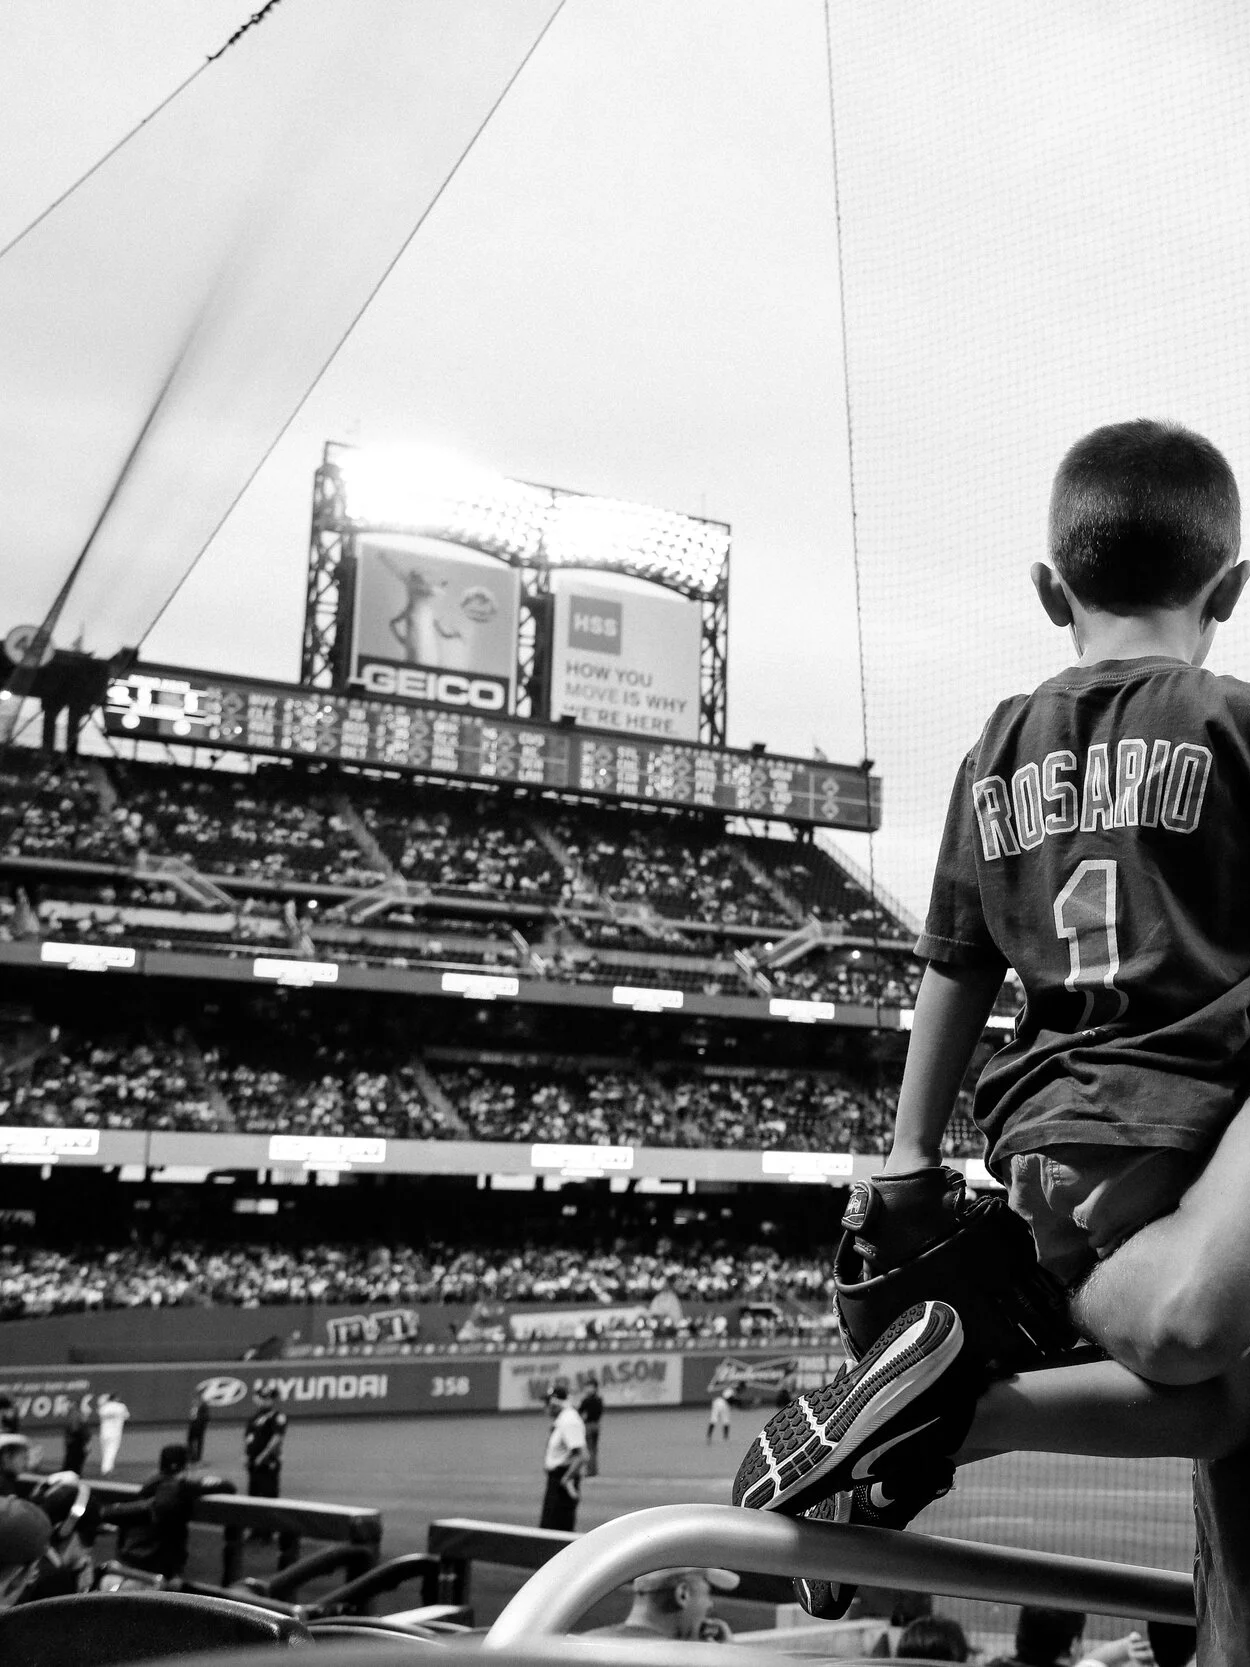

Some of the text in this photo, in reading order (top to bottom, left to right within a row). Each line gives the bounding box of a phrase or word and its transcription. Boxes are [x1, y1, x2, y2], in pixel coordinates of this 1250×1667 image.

[573, 612, 618, 637] HSS
[361, 662, 506, 711] GEICO
[566, 660, 653, 689] HOW YOU
[565, 682, 688, 713] MOVE IS WHY
[972, 738, 1213, 861] ROSARIO
[1053, 859, 1130, 1030] 1
[431, 1375, 470, 1397] 358
